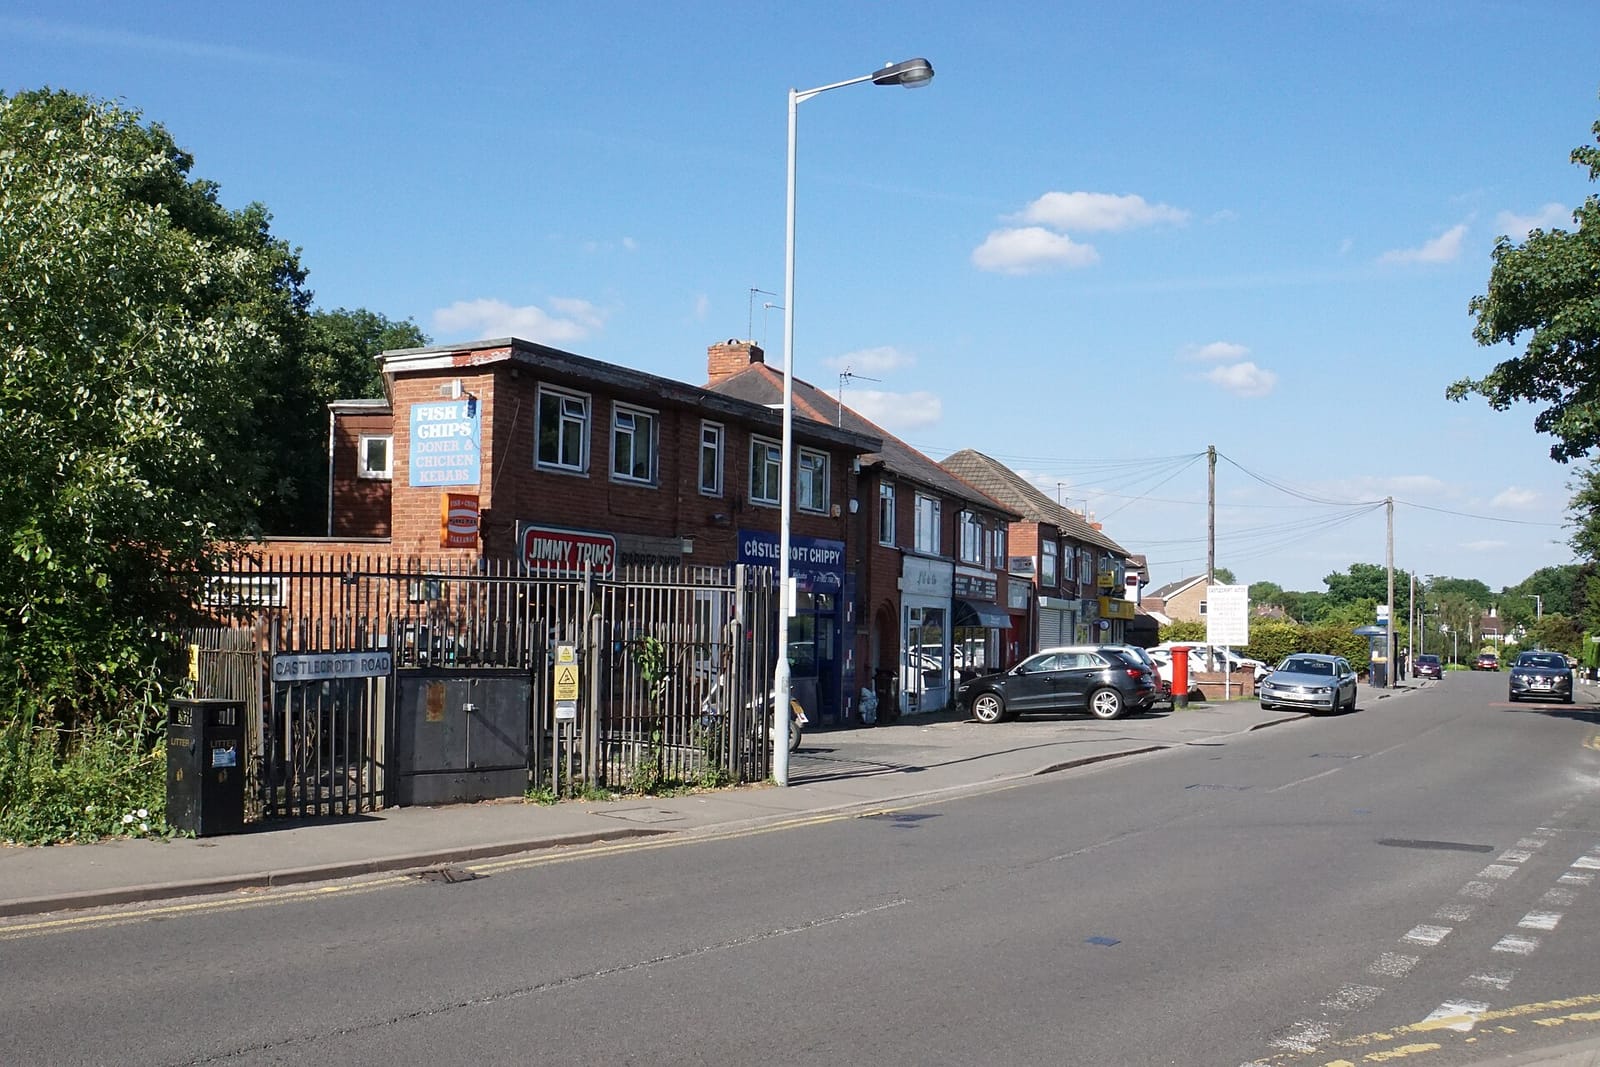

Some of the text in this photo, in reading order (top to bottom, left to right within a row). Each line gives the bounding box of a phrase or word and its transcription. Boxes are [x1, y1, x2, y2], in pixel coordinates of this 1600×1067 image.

[416, 405, 458, 421] FISH
[417, 422, 472, 439] CHIPS
[417, 439, 473, 453] DONER &
[415, 454, 473, 468] CHICKEN
[419, 469, 469, 482] KEBABS
[529, 538, 611, 567] JIMMY TRIMS
[744, 540, 840, 565] CASTLEROFT CHIPPY
[276, 657, 389, 675] CASTLECROFT ROAD
[170, 737, 190, 747] LITTER
